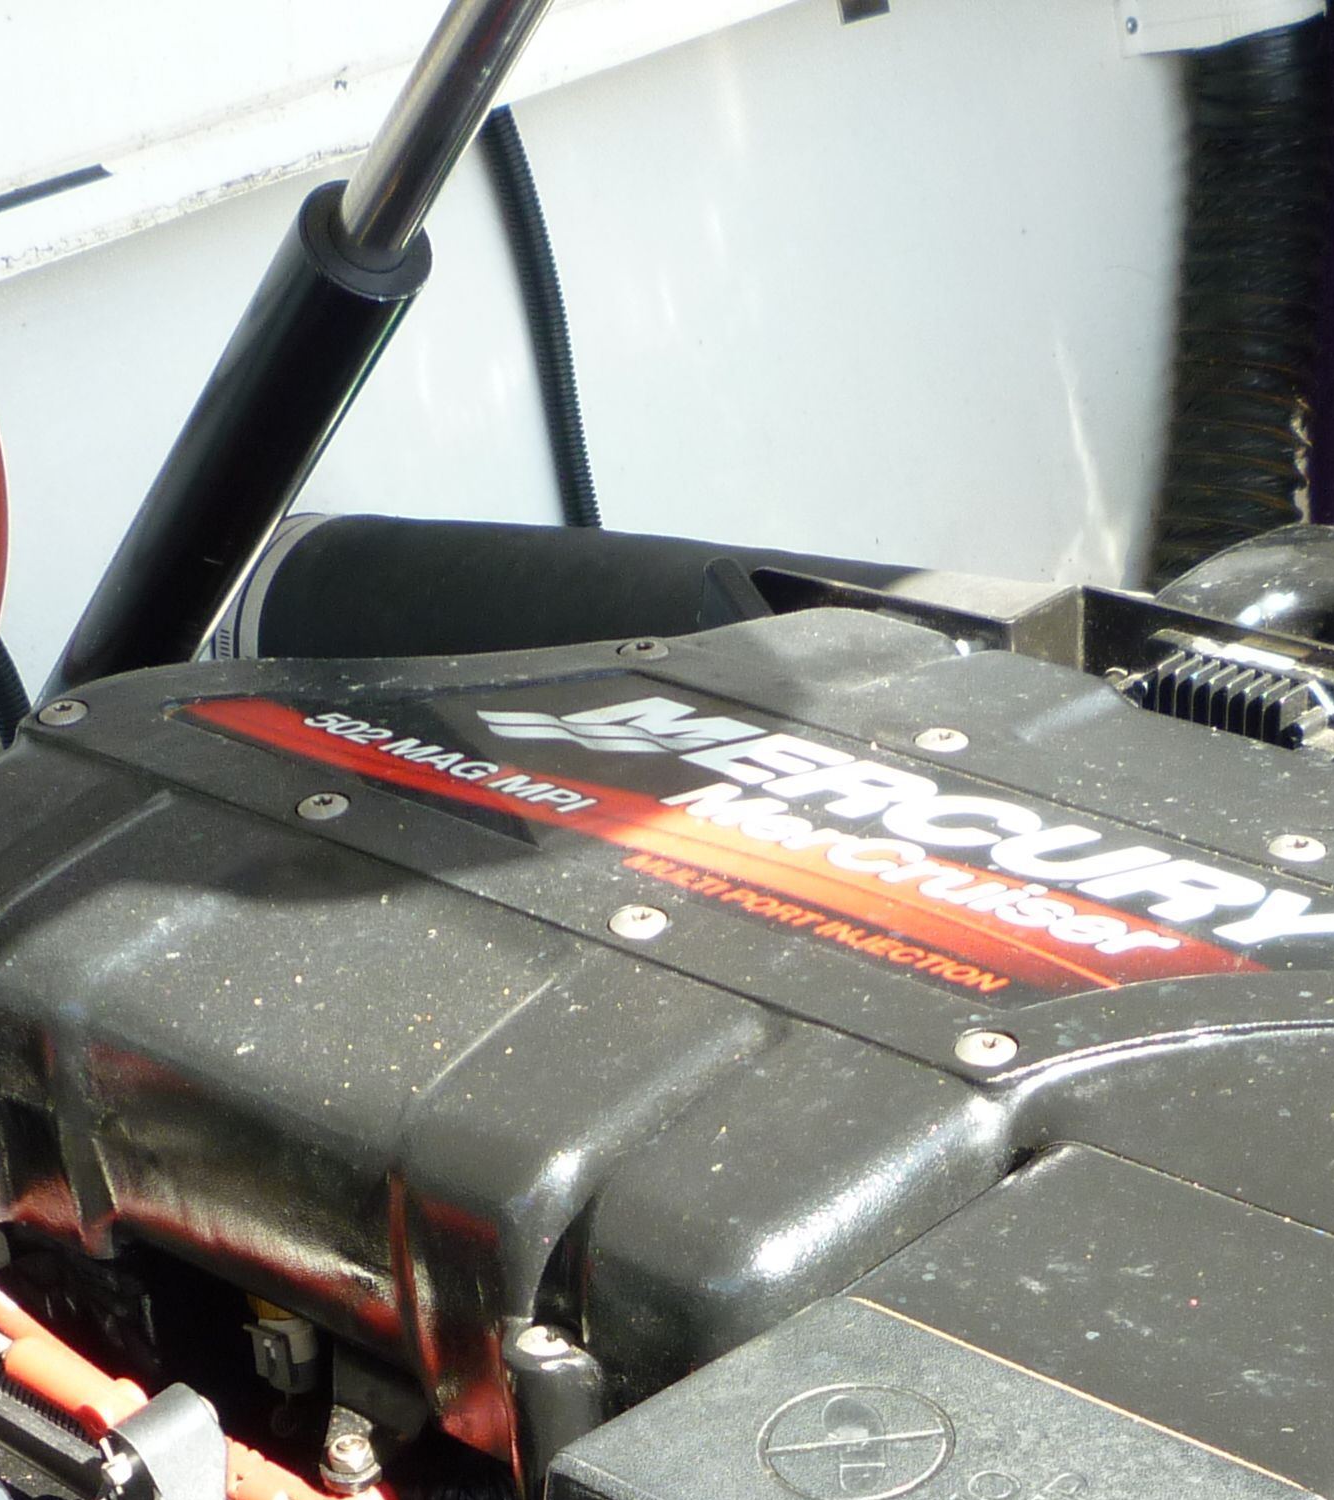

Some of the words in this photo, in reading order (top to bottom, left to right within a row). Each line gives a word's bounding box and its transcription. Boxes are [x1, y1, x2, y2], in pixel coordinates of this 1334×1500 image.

[302, 711, 393, 745] 502
[380, 736, 499, 783] MAG
[487, 773, 598, 814] MPI
[622, 853, 729, 898] MULTI
[720, 887, 827, 928] PORT
[811, 920, 1011, 994] INJECTION
[659, 782, 1181, 956] MerCruiser
